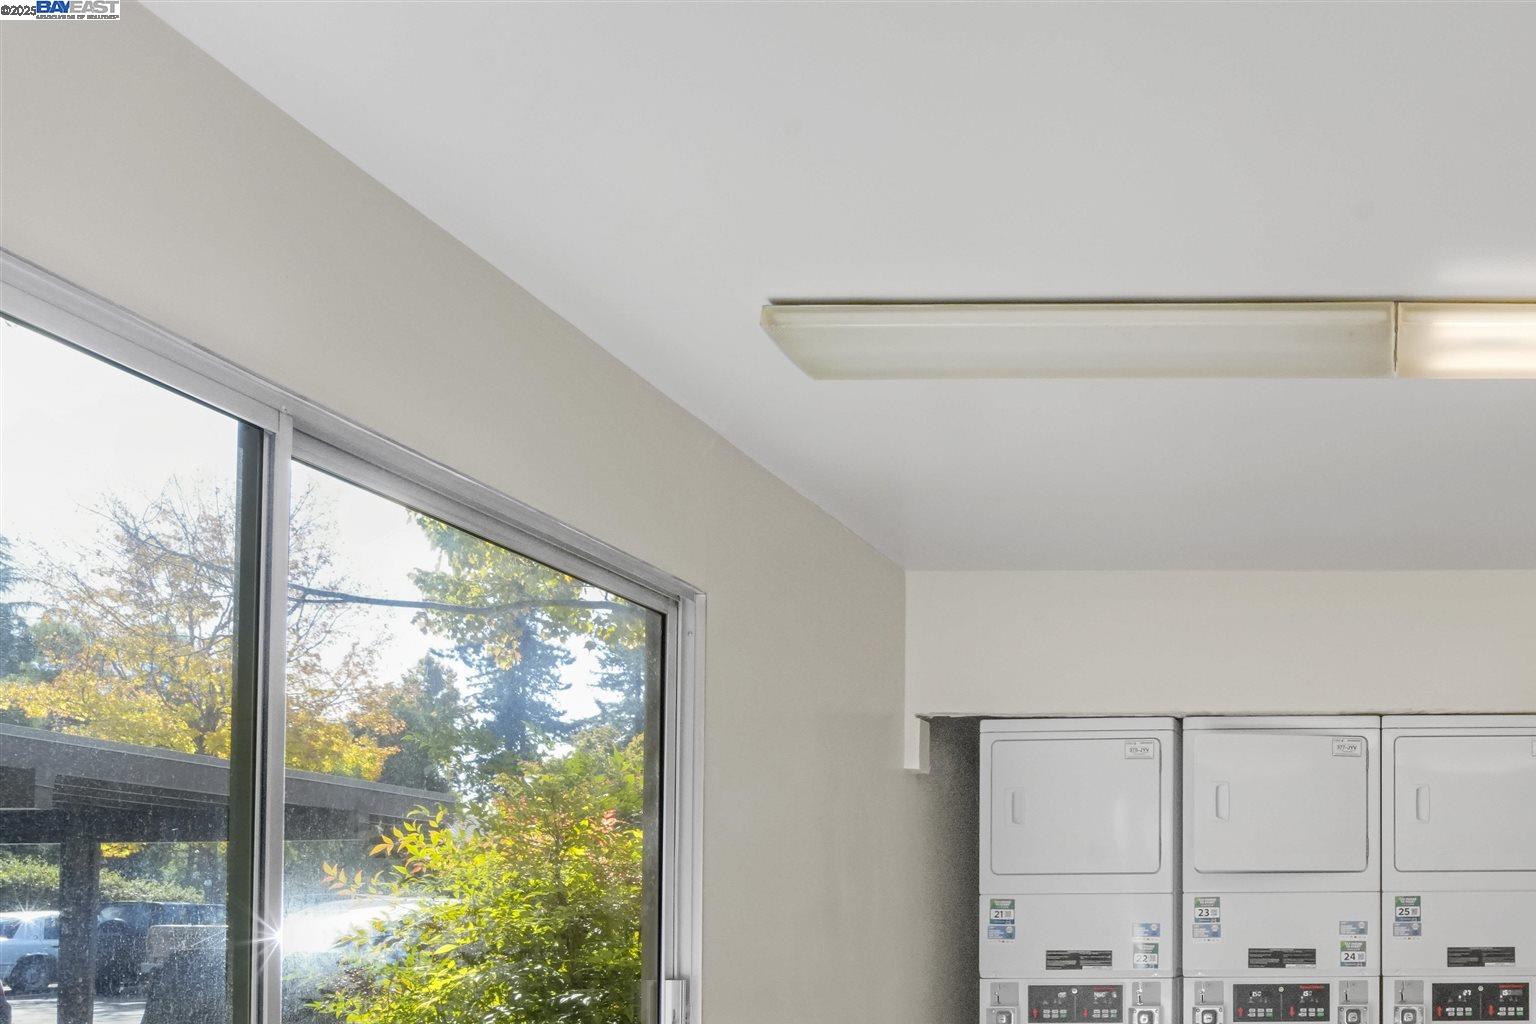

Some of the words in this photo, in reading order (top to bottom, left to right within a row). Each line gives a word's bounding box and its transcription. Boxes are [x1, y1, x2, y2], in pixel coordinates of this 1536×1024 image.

[994, 910, 1003, 918] 21
[1198, 908, 1210, 916] 23
[1398, 907, 1410, 915] 25
[1136, 954, 1148, 962] 22
[1344, 952, 1356, 960] 24
